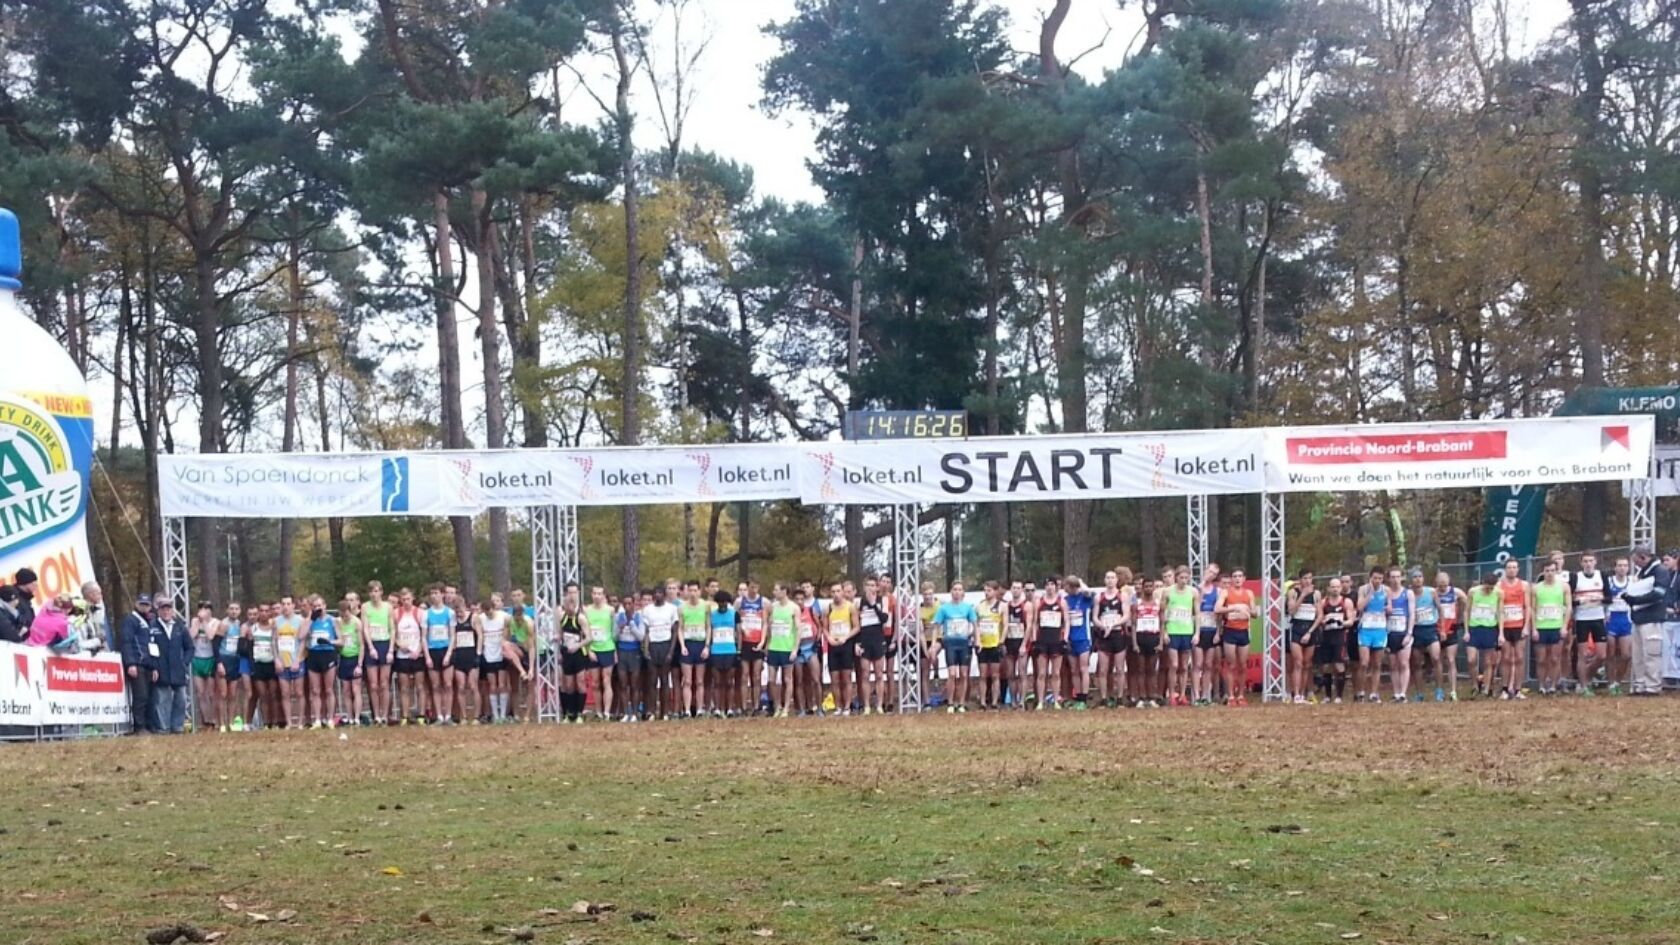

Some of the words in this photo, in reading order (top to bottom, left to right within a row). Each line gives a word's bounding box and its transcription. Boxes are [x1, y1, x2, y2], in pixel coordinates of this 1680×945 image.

[22, 413, 58, 451] DRINK
[868, 413, 964, 437] 14:16:26
[1298, 443, 1362, 457] Provincie
[1366, 439, 1474, 455] Noord-Brabant
[0, 439, 44, 497] A
[718, 463, 791, 483] loket.nl
[842, 465, 922, 484] loket.nl
[940, 447, 1122, 494] START
[1174, 453, 1255, 475] loket.nl
[1288, 472, 1325, 484] Want
[1330, 475, 1351, 484] we
[1357, 470, 1392, 483] doen
[1397, 469, 1420, 481] het
[1425, 467, 1493, 482] natuurlijk
[1500, 469, 1531, 478] voor
[1537, 465, 1566, 476] Ons
[1572, 462, 1632, 474] Brabant
[173, 464, 215, 483] Van
[224, 464, 369, 487] Spaendonck
[479, 470, 552, 488] loket.nl
[601, 468, 673, 486] loket.nl
[0, 488, 58, 539] INK
